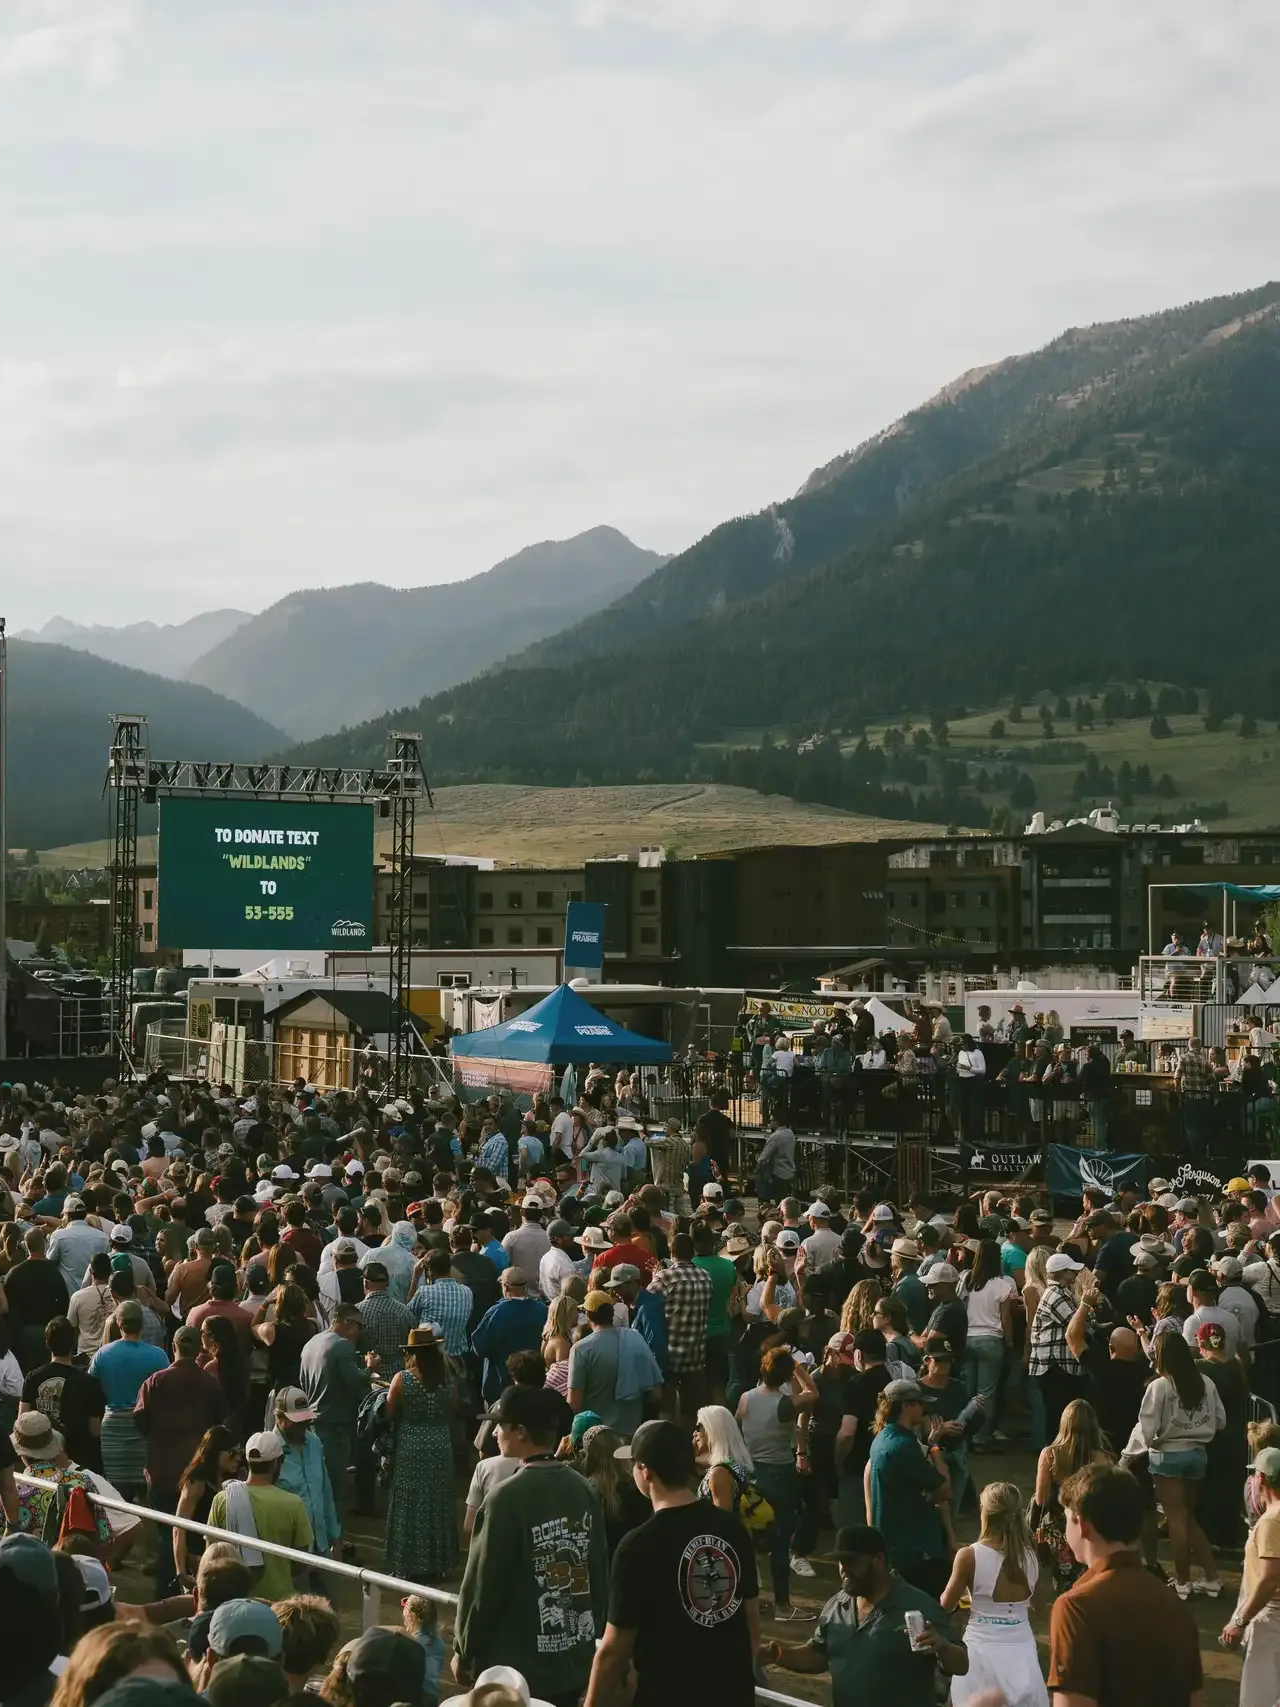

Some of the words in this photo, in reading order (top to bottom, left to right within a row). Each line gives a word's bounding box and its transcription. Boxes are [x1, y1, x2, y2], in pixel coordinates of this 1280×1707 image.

[214, 828, 232, 843] TO
[234, 829, 285, 844] DONATE
[286, 830, 320, 845] TEXT
[259, 880, 277, 895] TO
[245, 906, 294, 921] 53-555
[331, 927, 366, 937] WILDLANDS
[571, 934, 599, 943] PRAIRIE
[749, 1000, 786, 1015] ISND
[802, 1005, 851, 1017] NOODS
[991, 1154, 1043, 1165] OUTLAW
[992, 1164, 1027, 1172] REALTY
